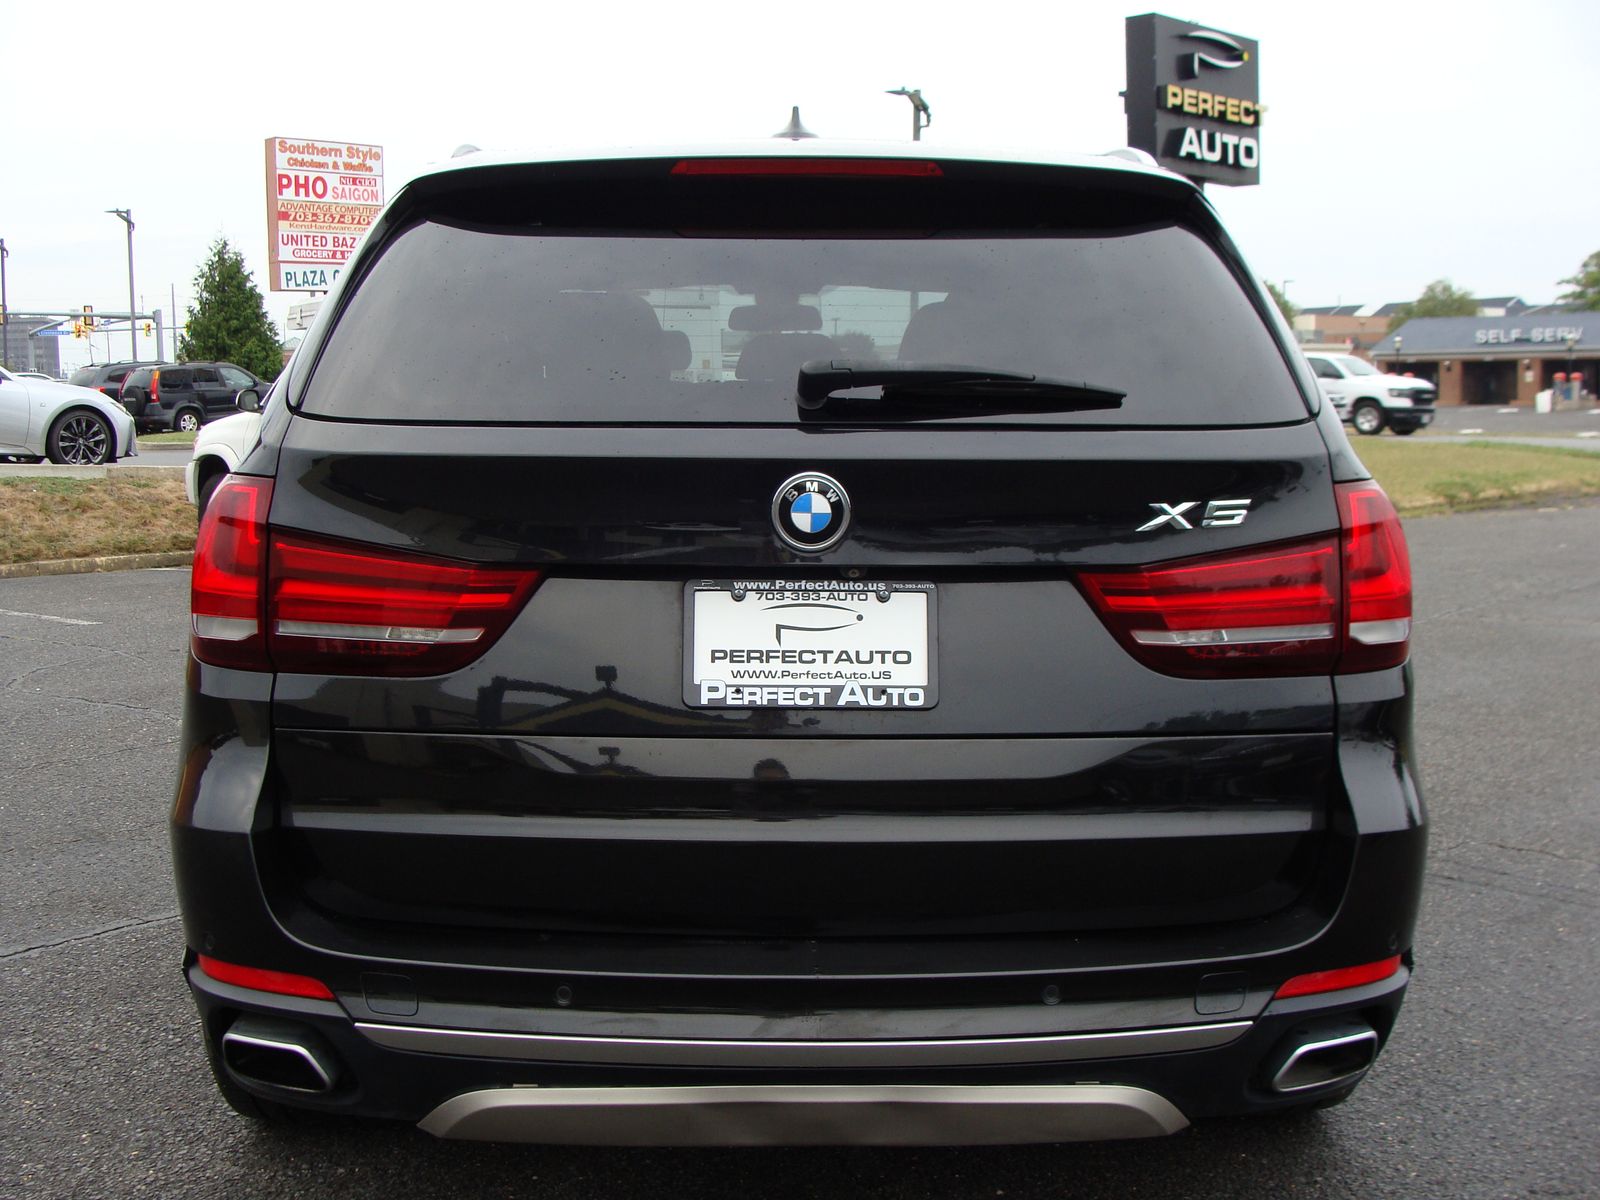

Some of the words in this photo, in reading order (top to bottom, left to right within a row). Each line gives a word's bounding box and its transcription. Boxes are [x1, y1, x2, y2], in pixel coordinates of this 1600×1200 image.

[1166, 84, 1267, 126] PERFECT
[278, 139, 343, 158] Southern
[346, 145, 382, 163] Style
[1179, 127, 1259, 168] AUTO
[277, 173, 328, 200] PHO
[331, 185, 379, 203] SAIGON
[279, 202, 333, 213] ADVANTAGE
[281, 233, 328, 248] UNITED
[294, 249, 334, 259] GROCERY
[335, 251, 343, 259] &
[285, 270, 328, 289] PLAZA
[785, 481, 840, 502] BMW
[1135, 499, 1252, 531] X5
[734, 580, 887, 591] www.PerfectAuto.us
[755, 592, 868, 602] 703-393-AUTO
[711, 650, 912, 665] PERFECTAUTO
[731, 670, 892, 680] WWW.PerfectAuto.US
